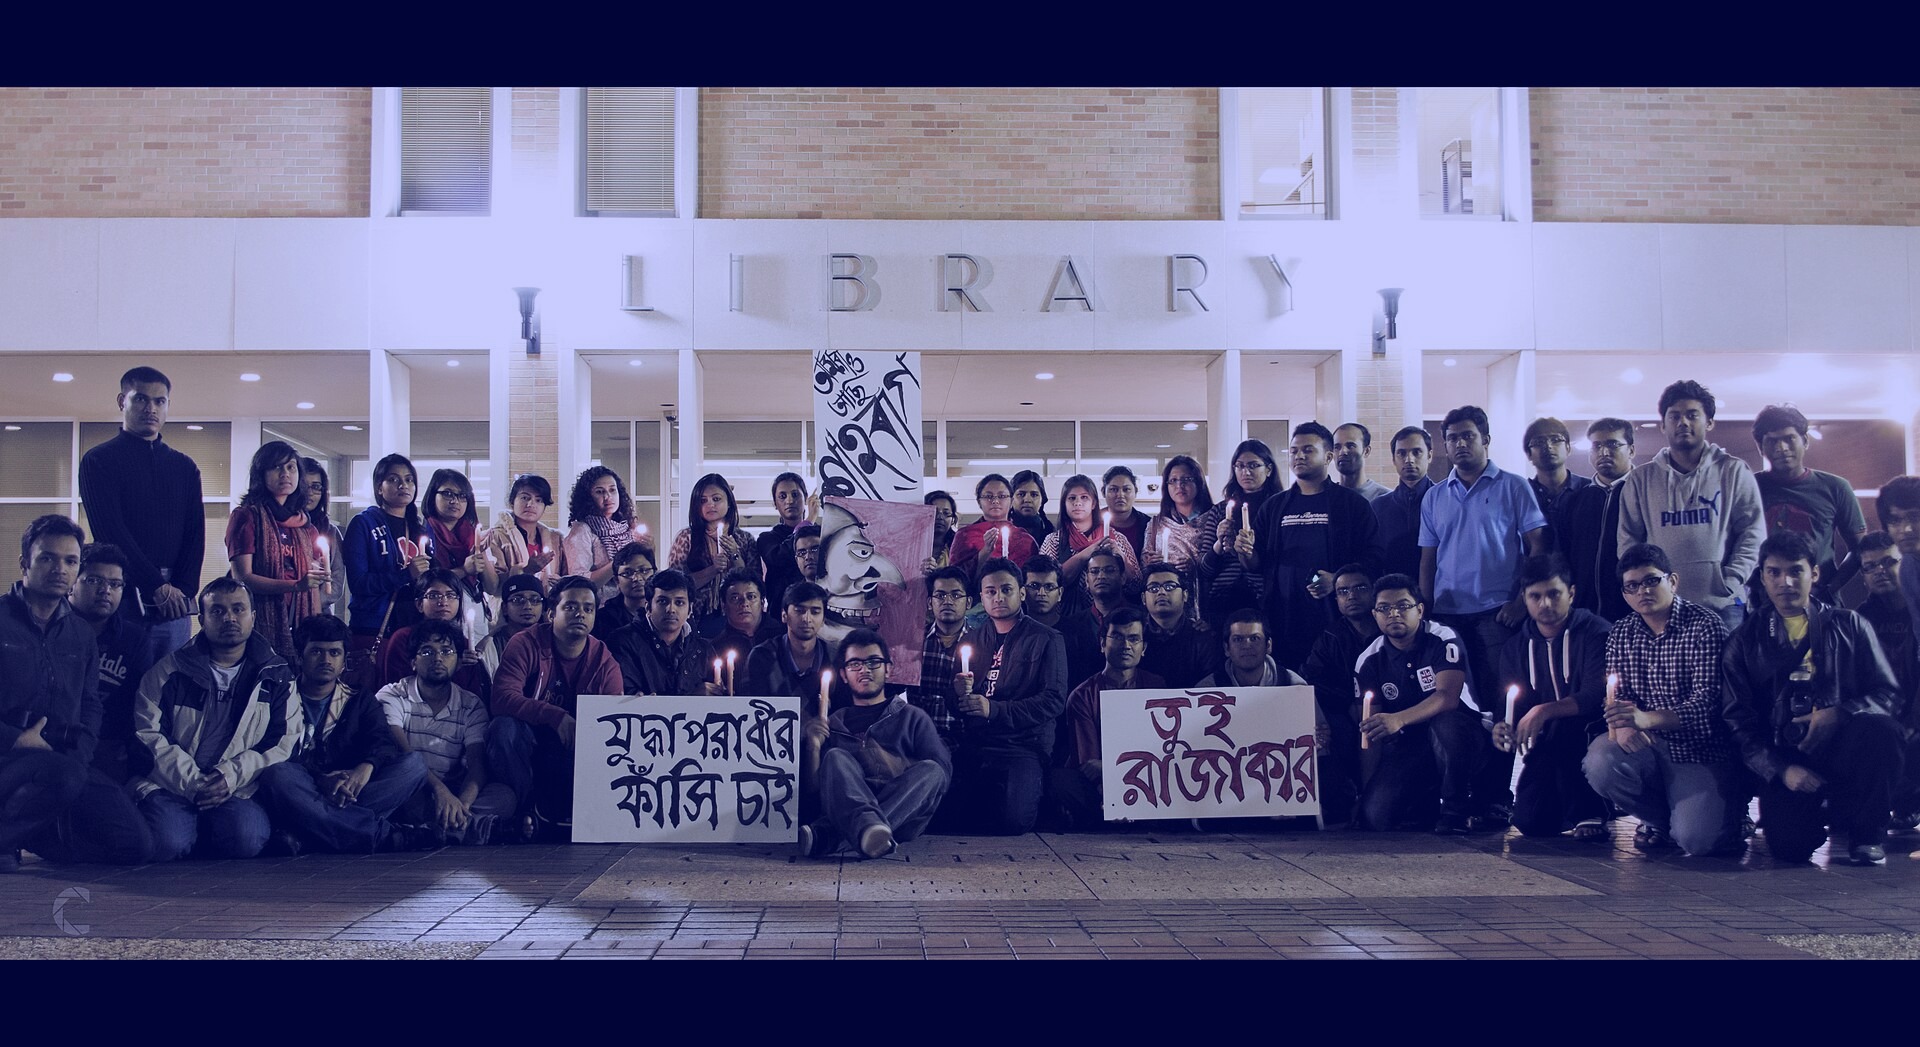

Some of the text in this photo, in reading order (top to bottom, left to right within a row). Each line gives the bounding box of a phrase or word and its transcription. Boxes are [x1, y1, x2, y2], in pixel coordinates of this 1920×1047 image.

[619, 252, 1301, 313] LIBRARY
[1660, 507, 1713, 528] PUMA
[596, 698, 799, 767] যুদ্ধাপরাধীর
[1144, 689, 1237, 755] তুই
[609, 757, 724, 831] ফাঁসি
[729, 752, 796, 830] চাই
[1115, 735, 1318, 809] রাজাকার
